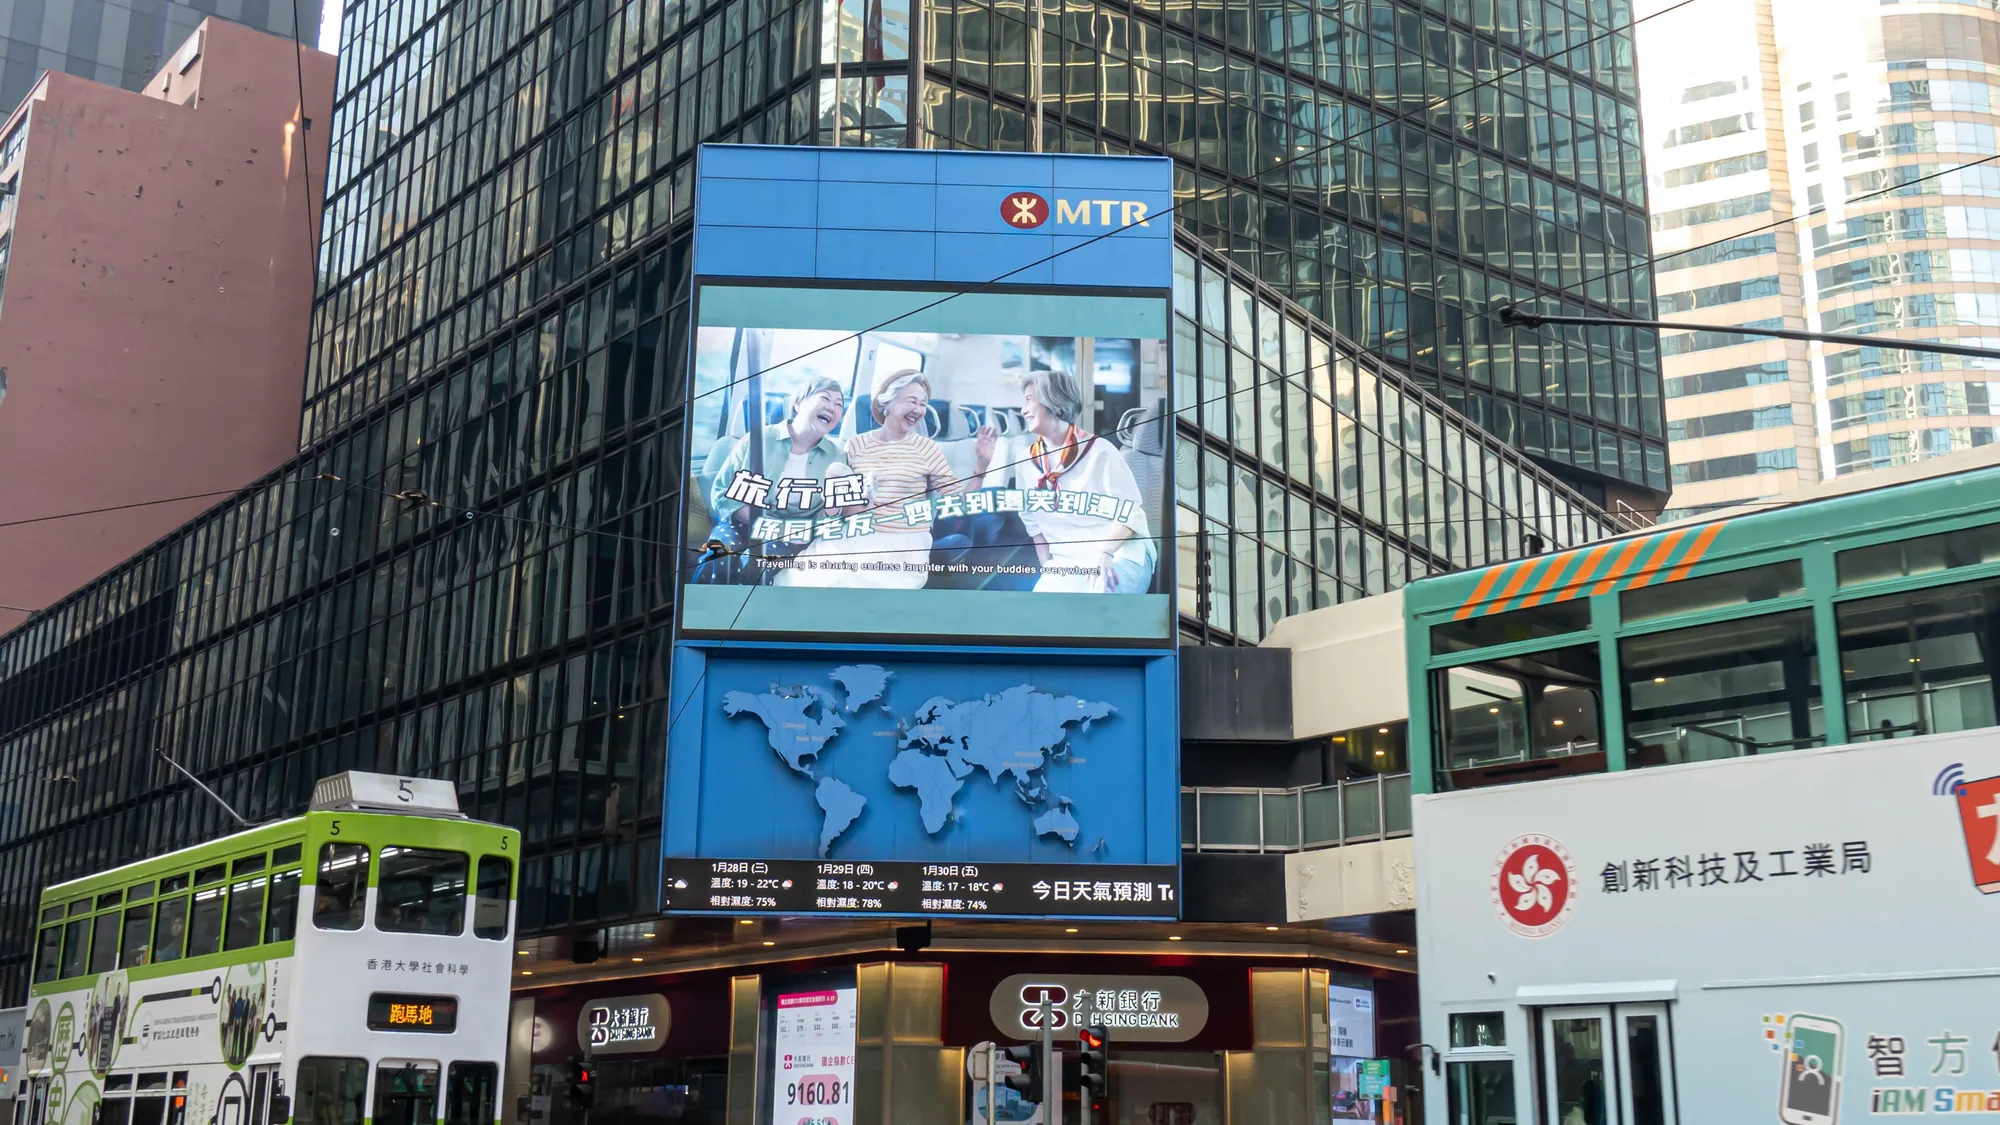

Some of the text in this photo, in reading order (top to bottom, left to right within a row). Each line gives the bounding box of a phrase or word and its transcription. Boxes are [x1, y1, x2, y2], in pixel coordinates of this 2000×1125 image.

[1056, 199, 1150, 227] MTR
[725, 469, 869, 510] 旅行感
[755, 558, 1101, 577] Travelling is sharing endless laughter with your buddies everywhere!
[397, 779, 414, 802] 5
[330, 820, 341, 835] 5
[500, 836, 509, 850] 5
[711, 862, 768, 874] 1月28日 (三)
[817, 864, 873, 875] 1月29日 (四)
[922, 866, 978, 877] 1月30日 (五)
[1600, 841, 1872, 894] 創新科技及工業局
[737, 879, 748, 888] 19
[843, 881, 853, 889] 18
[948, 882, 958, 891] 17
[1032, 880, 1152, 902] 今日天氣預測
[756, 897, 776, 907] 75%
[862, 899, 882, 908] 78%
[967, 900, 987, 910] 74%
[367, 958, 469, 975] 香港大學社會科學
[389, 1004, 433, 1025] 跑馬地
[1073, 1013, 1179, 1028] DH SING BANK
[788, 1081, 849, 1105] 9160.81
[1872, 1088, 1927, 1113] iAM
